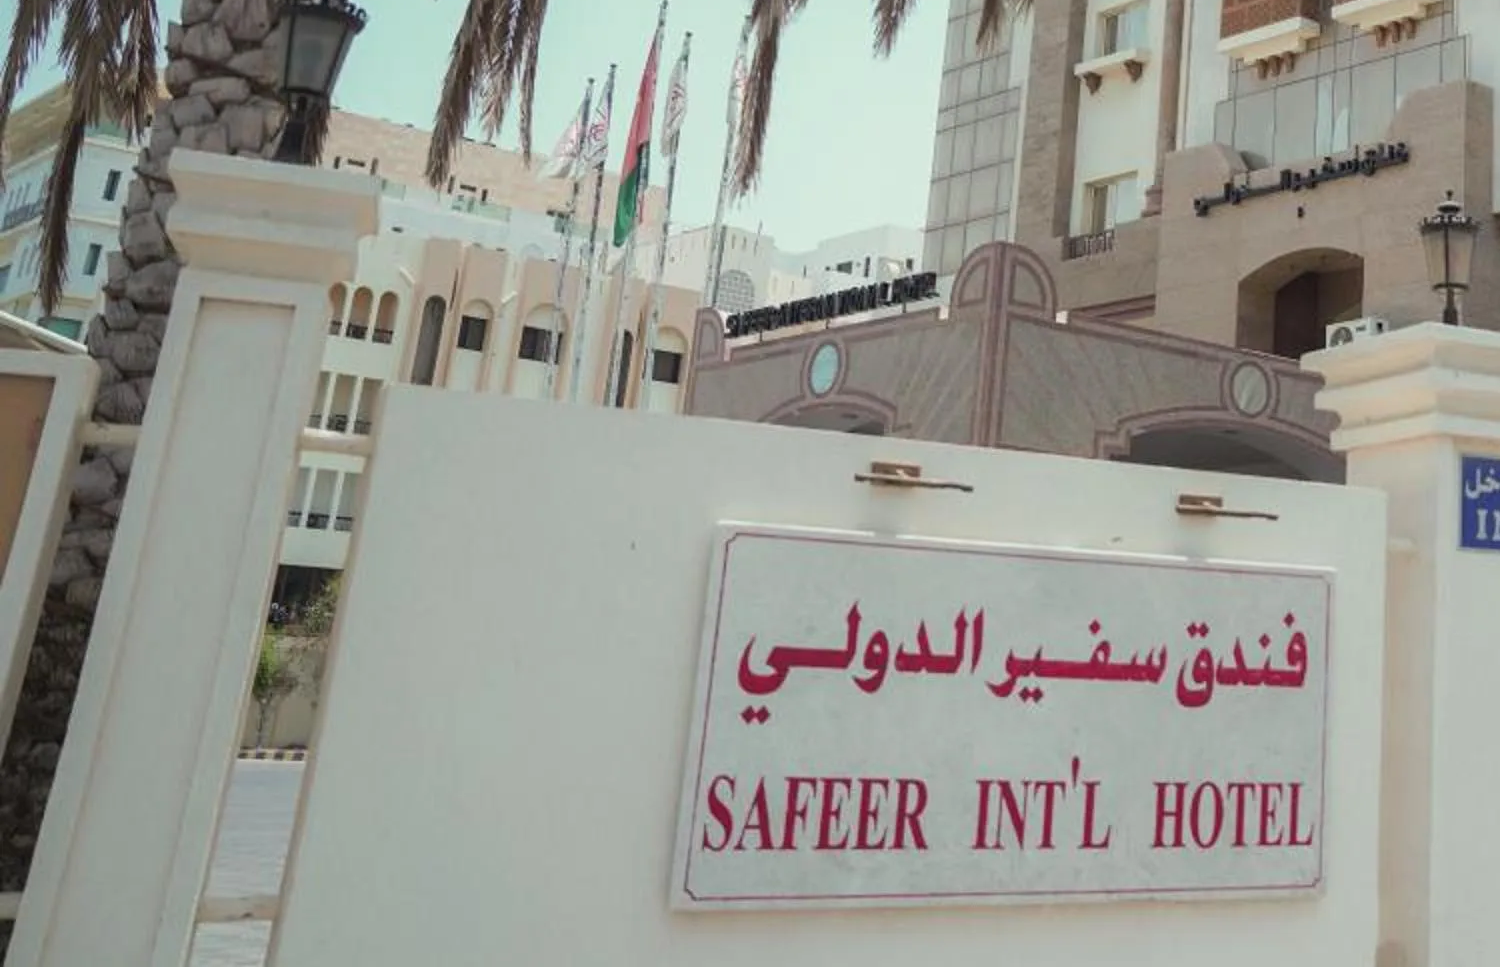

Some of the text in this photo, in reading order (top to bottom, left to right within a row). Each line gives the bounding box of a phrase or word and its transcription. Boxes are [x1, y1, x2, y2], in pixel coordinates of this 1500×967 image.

[736, 599, 1308, 725] فندق سفير الدولي
[701, 755, 1315, 852] SAFEER INT'L HOTEL
